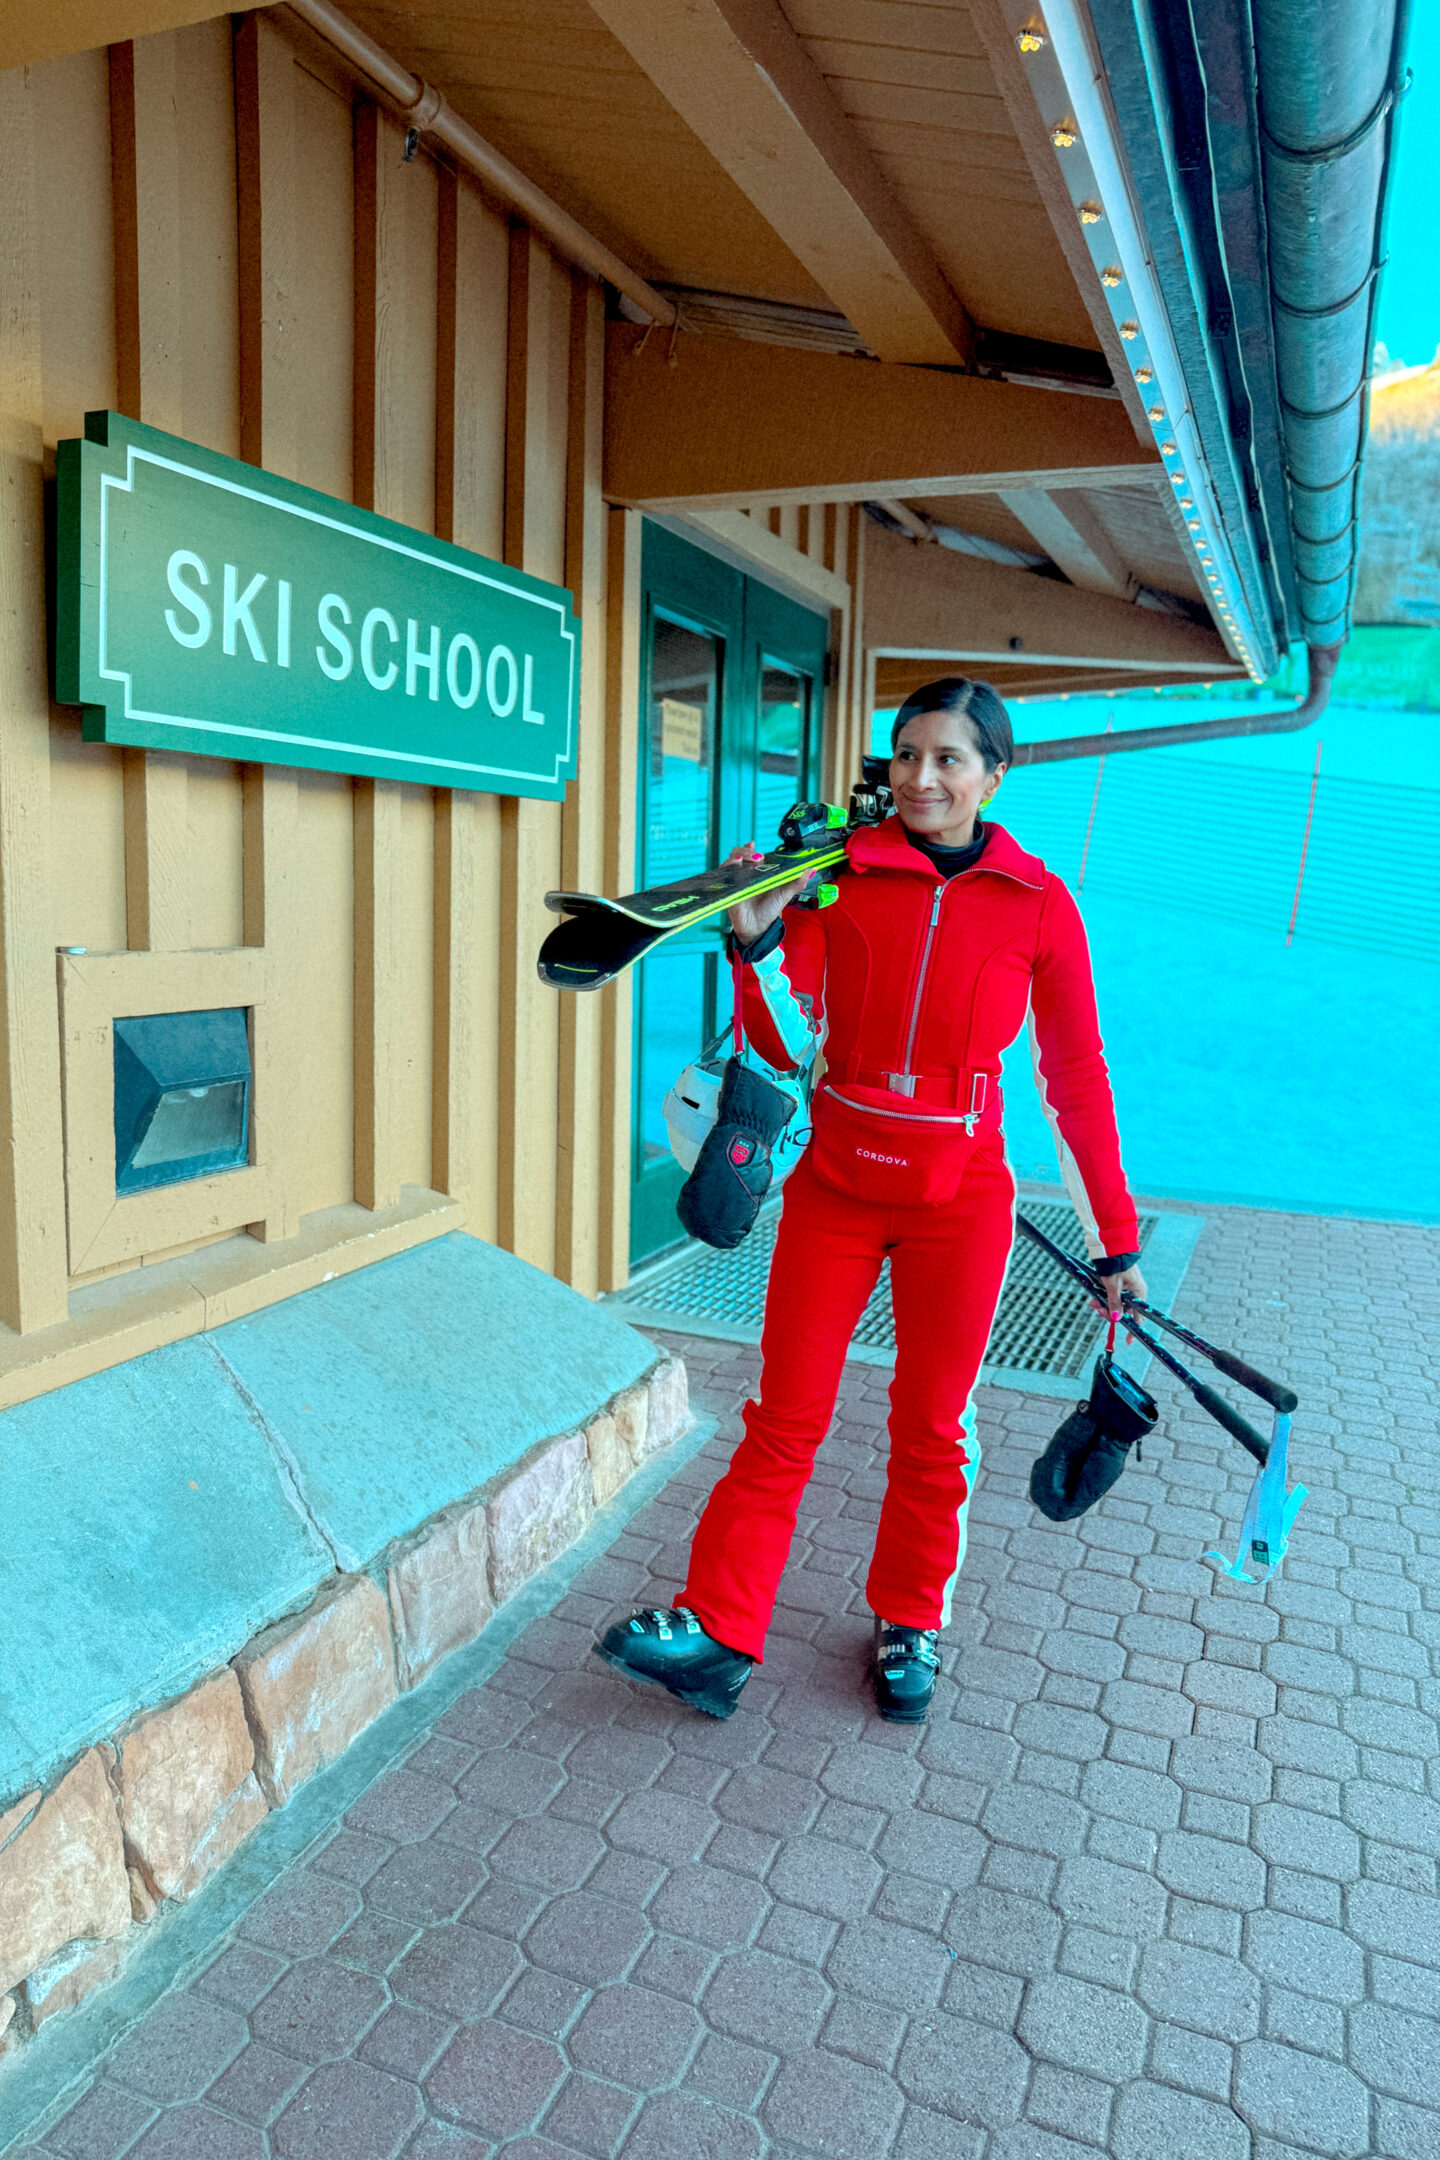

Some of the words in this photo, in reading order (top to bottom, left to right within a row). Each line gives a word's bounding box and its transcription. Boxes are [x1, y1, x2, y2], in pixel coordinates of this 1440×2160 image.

[164, 549, 291, 668] SKI
[316, 593, 545, 725] SCHOOL
[856, 1148, 907, 1167] CORDOVA
